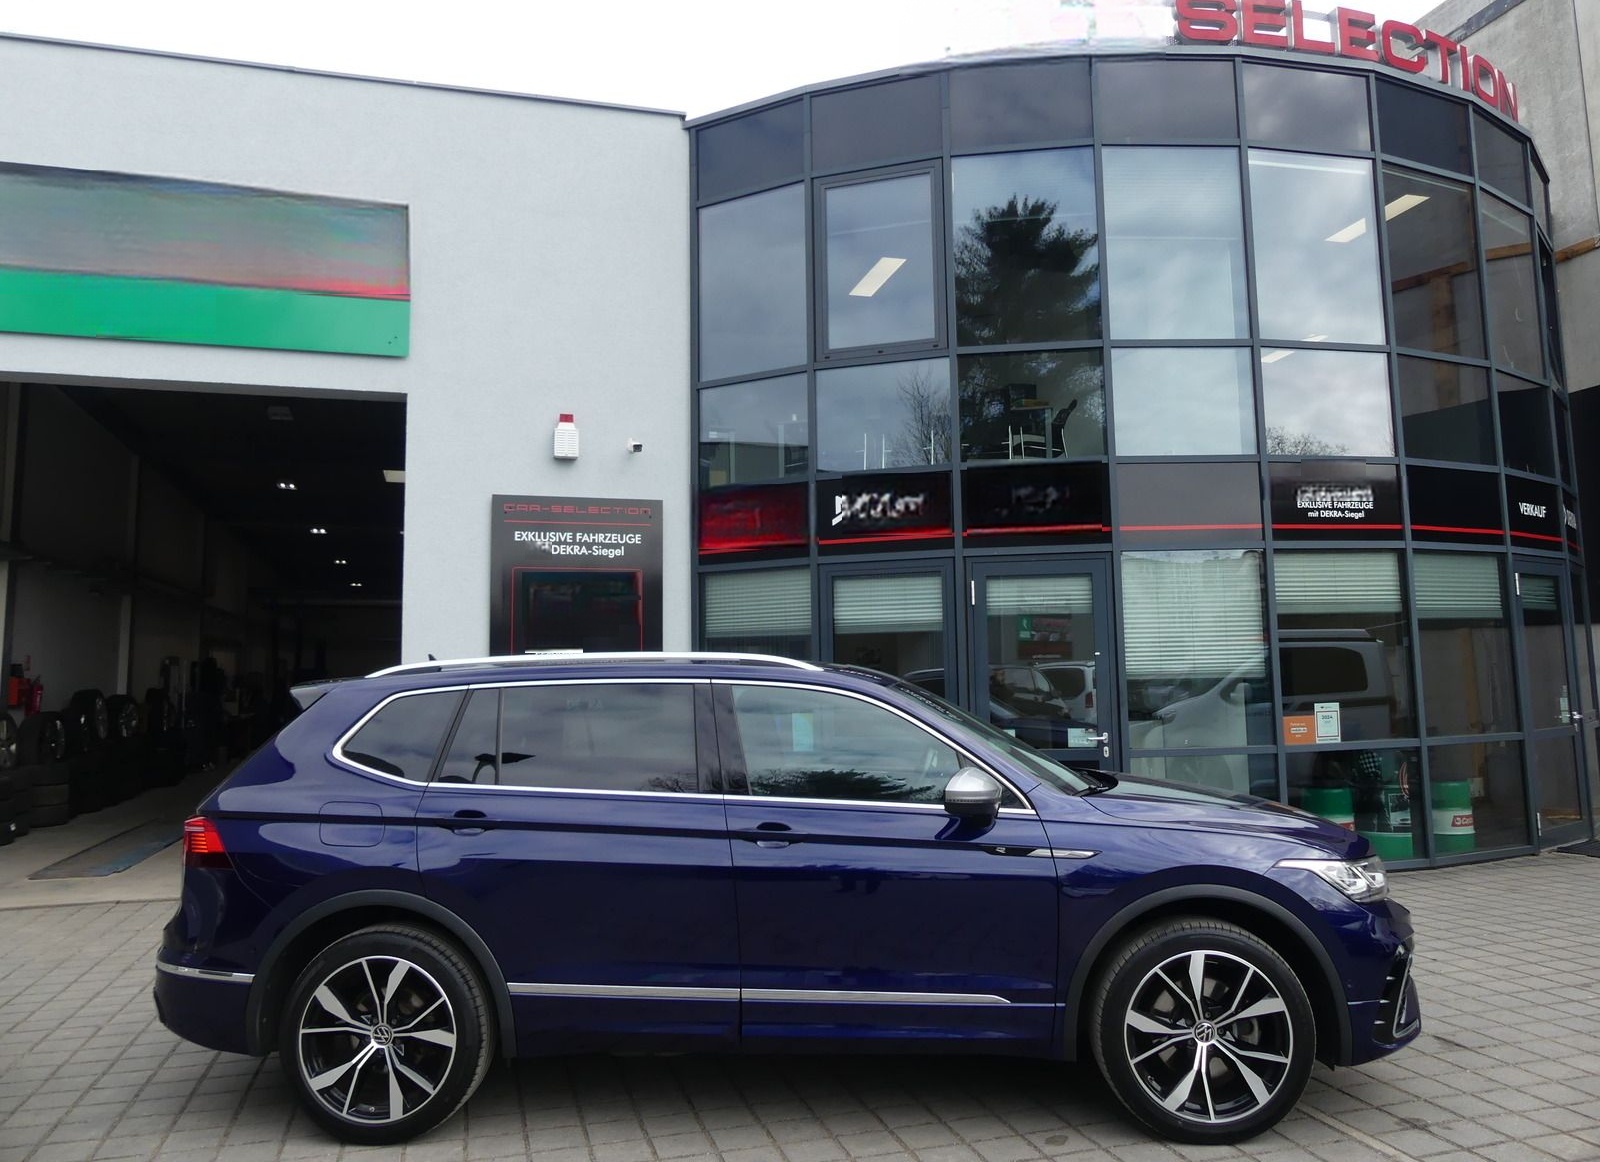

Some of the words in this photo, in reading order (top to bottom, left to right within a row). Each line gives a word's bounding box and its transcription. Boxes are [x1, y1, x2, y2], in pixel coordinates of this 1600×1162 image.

[1174, 0, 1519, 122] SELECTION
[504, 503, 651, 515] CAR-SELECTION
[1297, 501, 1332, 509] EXKLUSIVE
[1334, 501, 1374, 509] FAHRZEUGE
[1519, 502, 1547, 518] VERKAUF
[1308, 510, 1319, 518] mit
[1320, 510, 1365, 519] DEKRA-Siegel
[514, 531, 573, 543] EXKLUSIVE
[576, 533, 642, 544] FAHRZEUGE
[551, 545, 625, 558] DEKRA-Siegel
